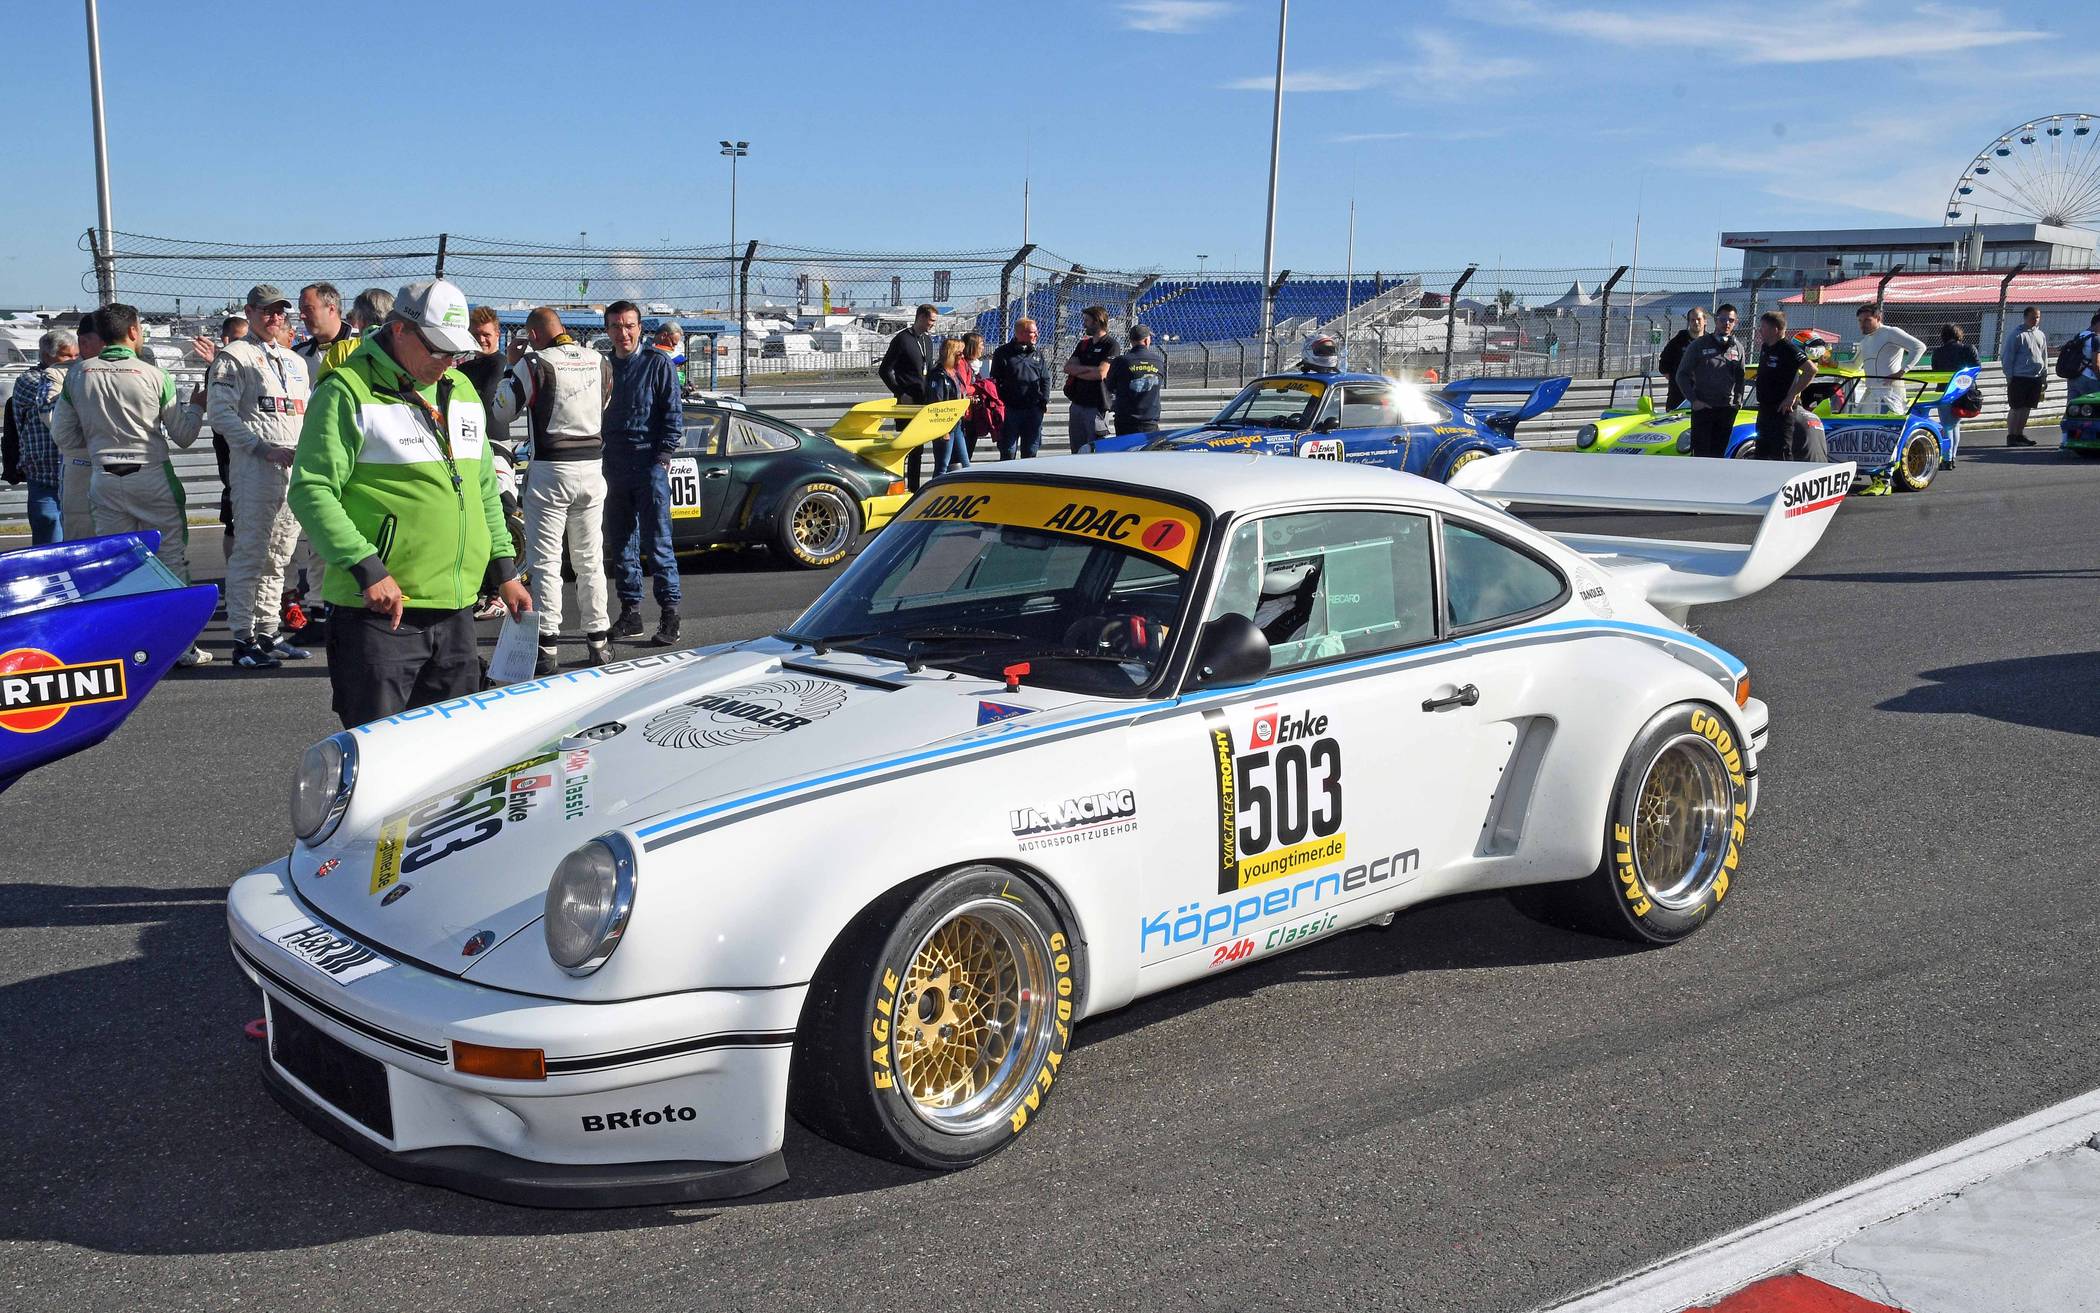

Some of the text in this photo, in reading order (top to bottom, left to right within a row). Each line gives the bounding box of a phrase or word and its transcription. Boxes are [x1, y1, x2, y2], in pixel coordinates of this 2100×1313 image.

[1861, 430, 1899, 452] BUSC
[669, 465, 693, 475] Enke
[807, 482, 836, 493] EAGLE
[671, 476, 697, 506] 05
[915, 495, 1171, 548] ADAC ADAC 1
[0, 667, 115, 706] RTINI
[684, 694, 813, 732] TANDLER
[1276, 709, 1329, 744] Enke
[507, 790, 538, 823] Enke
[1236, 737, 1343, 856] 503
[400, 775, 508, 874] 503
[1243, 840, 1342, 884] youngtimer.de
[1615, 822, 1652, 918] EAGLE
[278, 924, 354, 962] H&R
[1211, 911, 1339, 966] 24h Classic
[872, 967, 900, 1090] EAGLE
[581, 1104, 697, 1132] BRfoto
